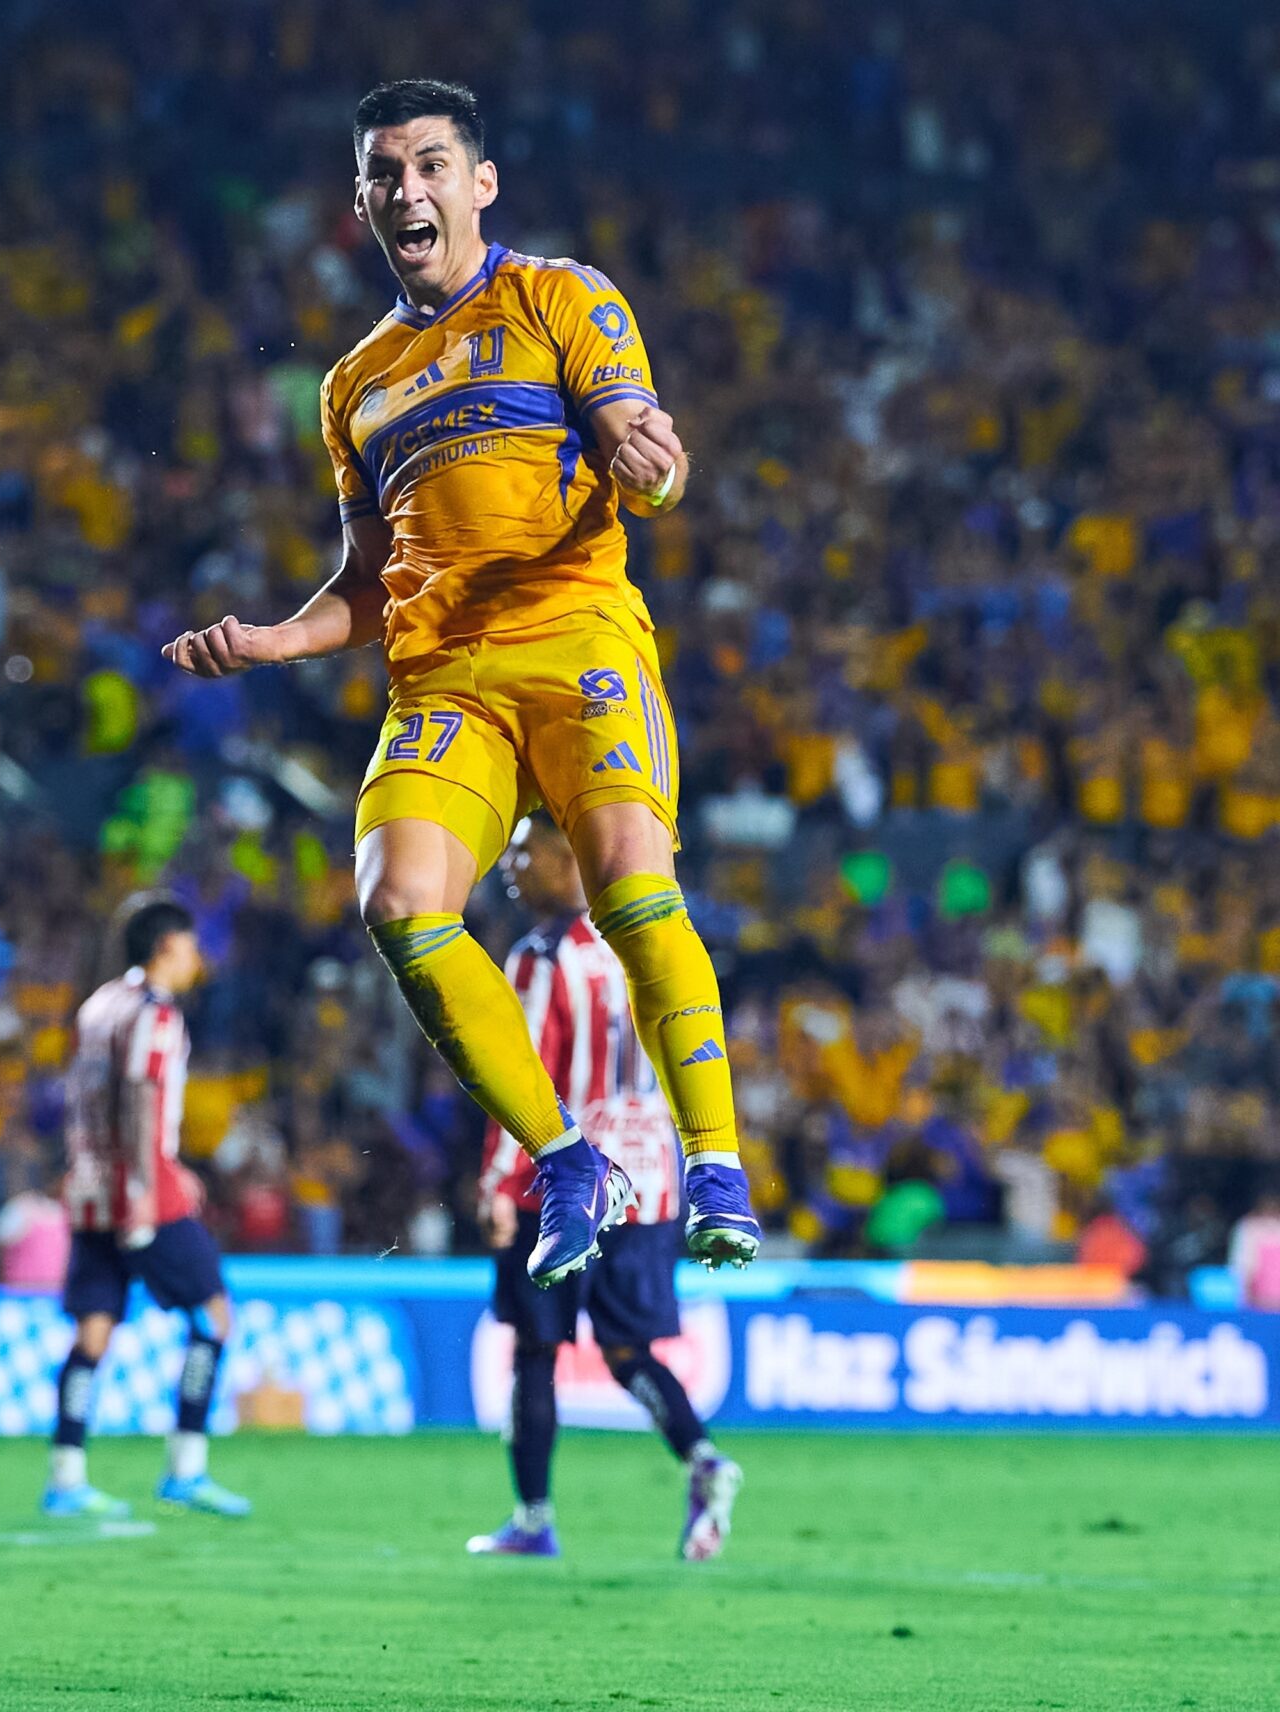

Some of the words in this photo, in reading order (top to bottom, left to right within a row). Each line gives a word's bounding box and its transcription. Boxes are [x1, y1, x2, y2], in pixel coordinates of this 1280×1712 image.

[592, 362, 643, 386] telcel
[385, 711, 463, 763] 27
[658, 1004, 723, 1025] TIGR
[746, 1313, 900, 1413] Haz
[902, 1315, 1268, 1418] Sándwich
